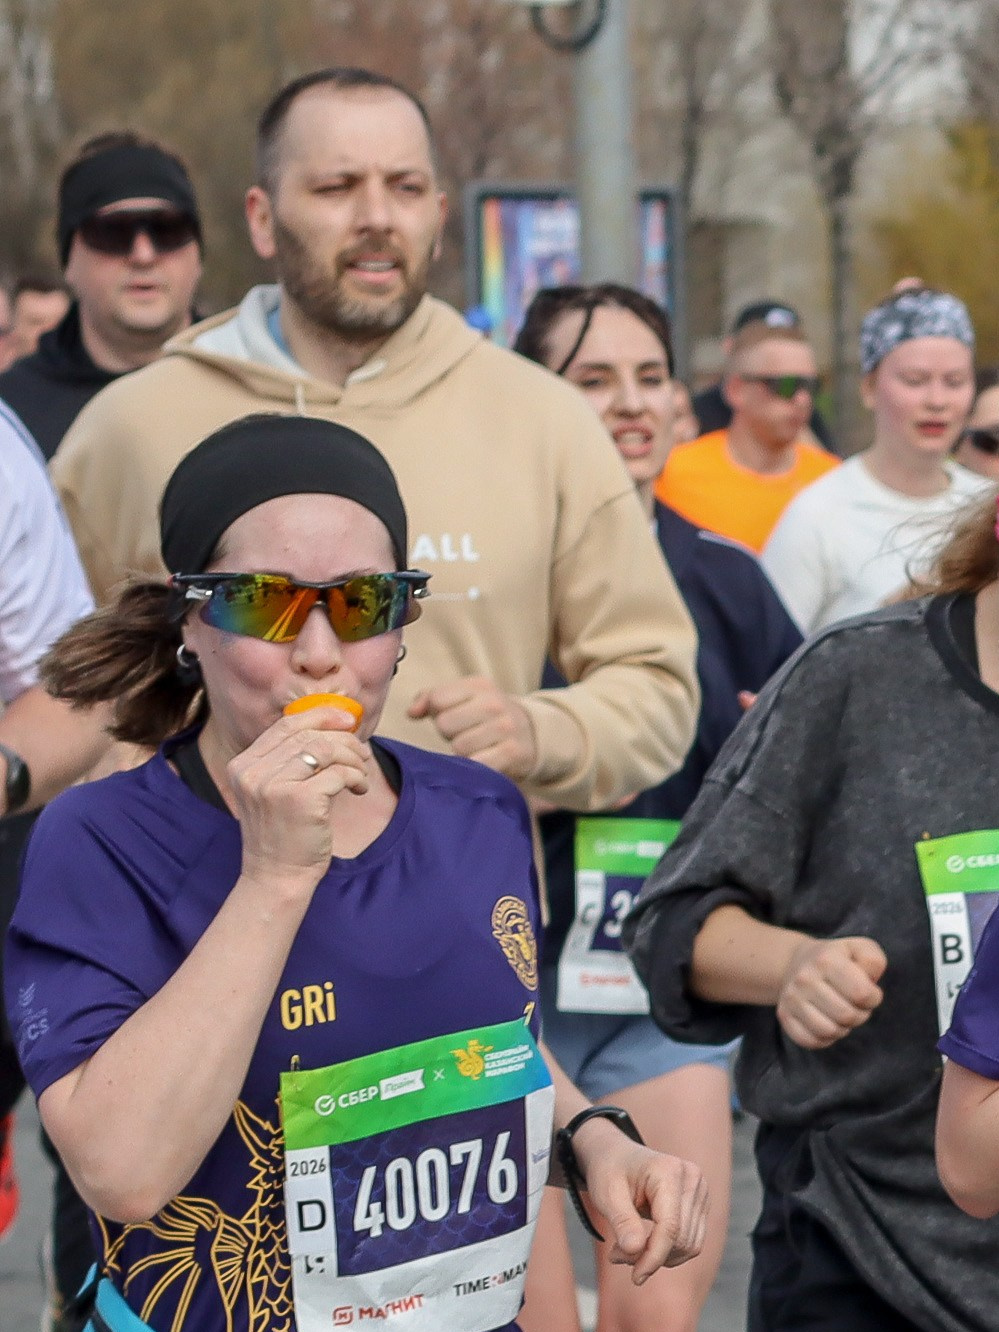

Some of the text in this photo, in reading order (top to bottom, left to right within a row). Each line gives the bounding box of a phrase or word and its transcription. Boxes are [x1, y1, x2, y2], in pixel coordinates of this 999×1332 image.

[940, 934, 964, 965] B
[338, 1085, 379, 1109] СБЕР
[290, 1157, 328, 1177] 2026
[353, 1131, 518, 1239] 40076
[297, 1199, 326, 1232] D
[358, 1293, 425, 1320] МАГНИТ
